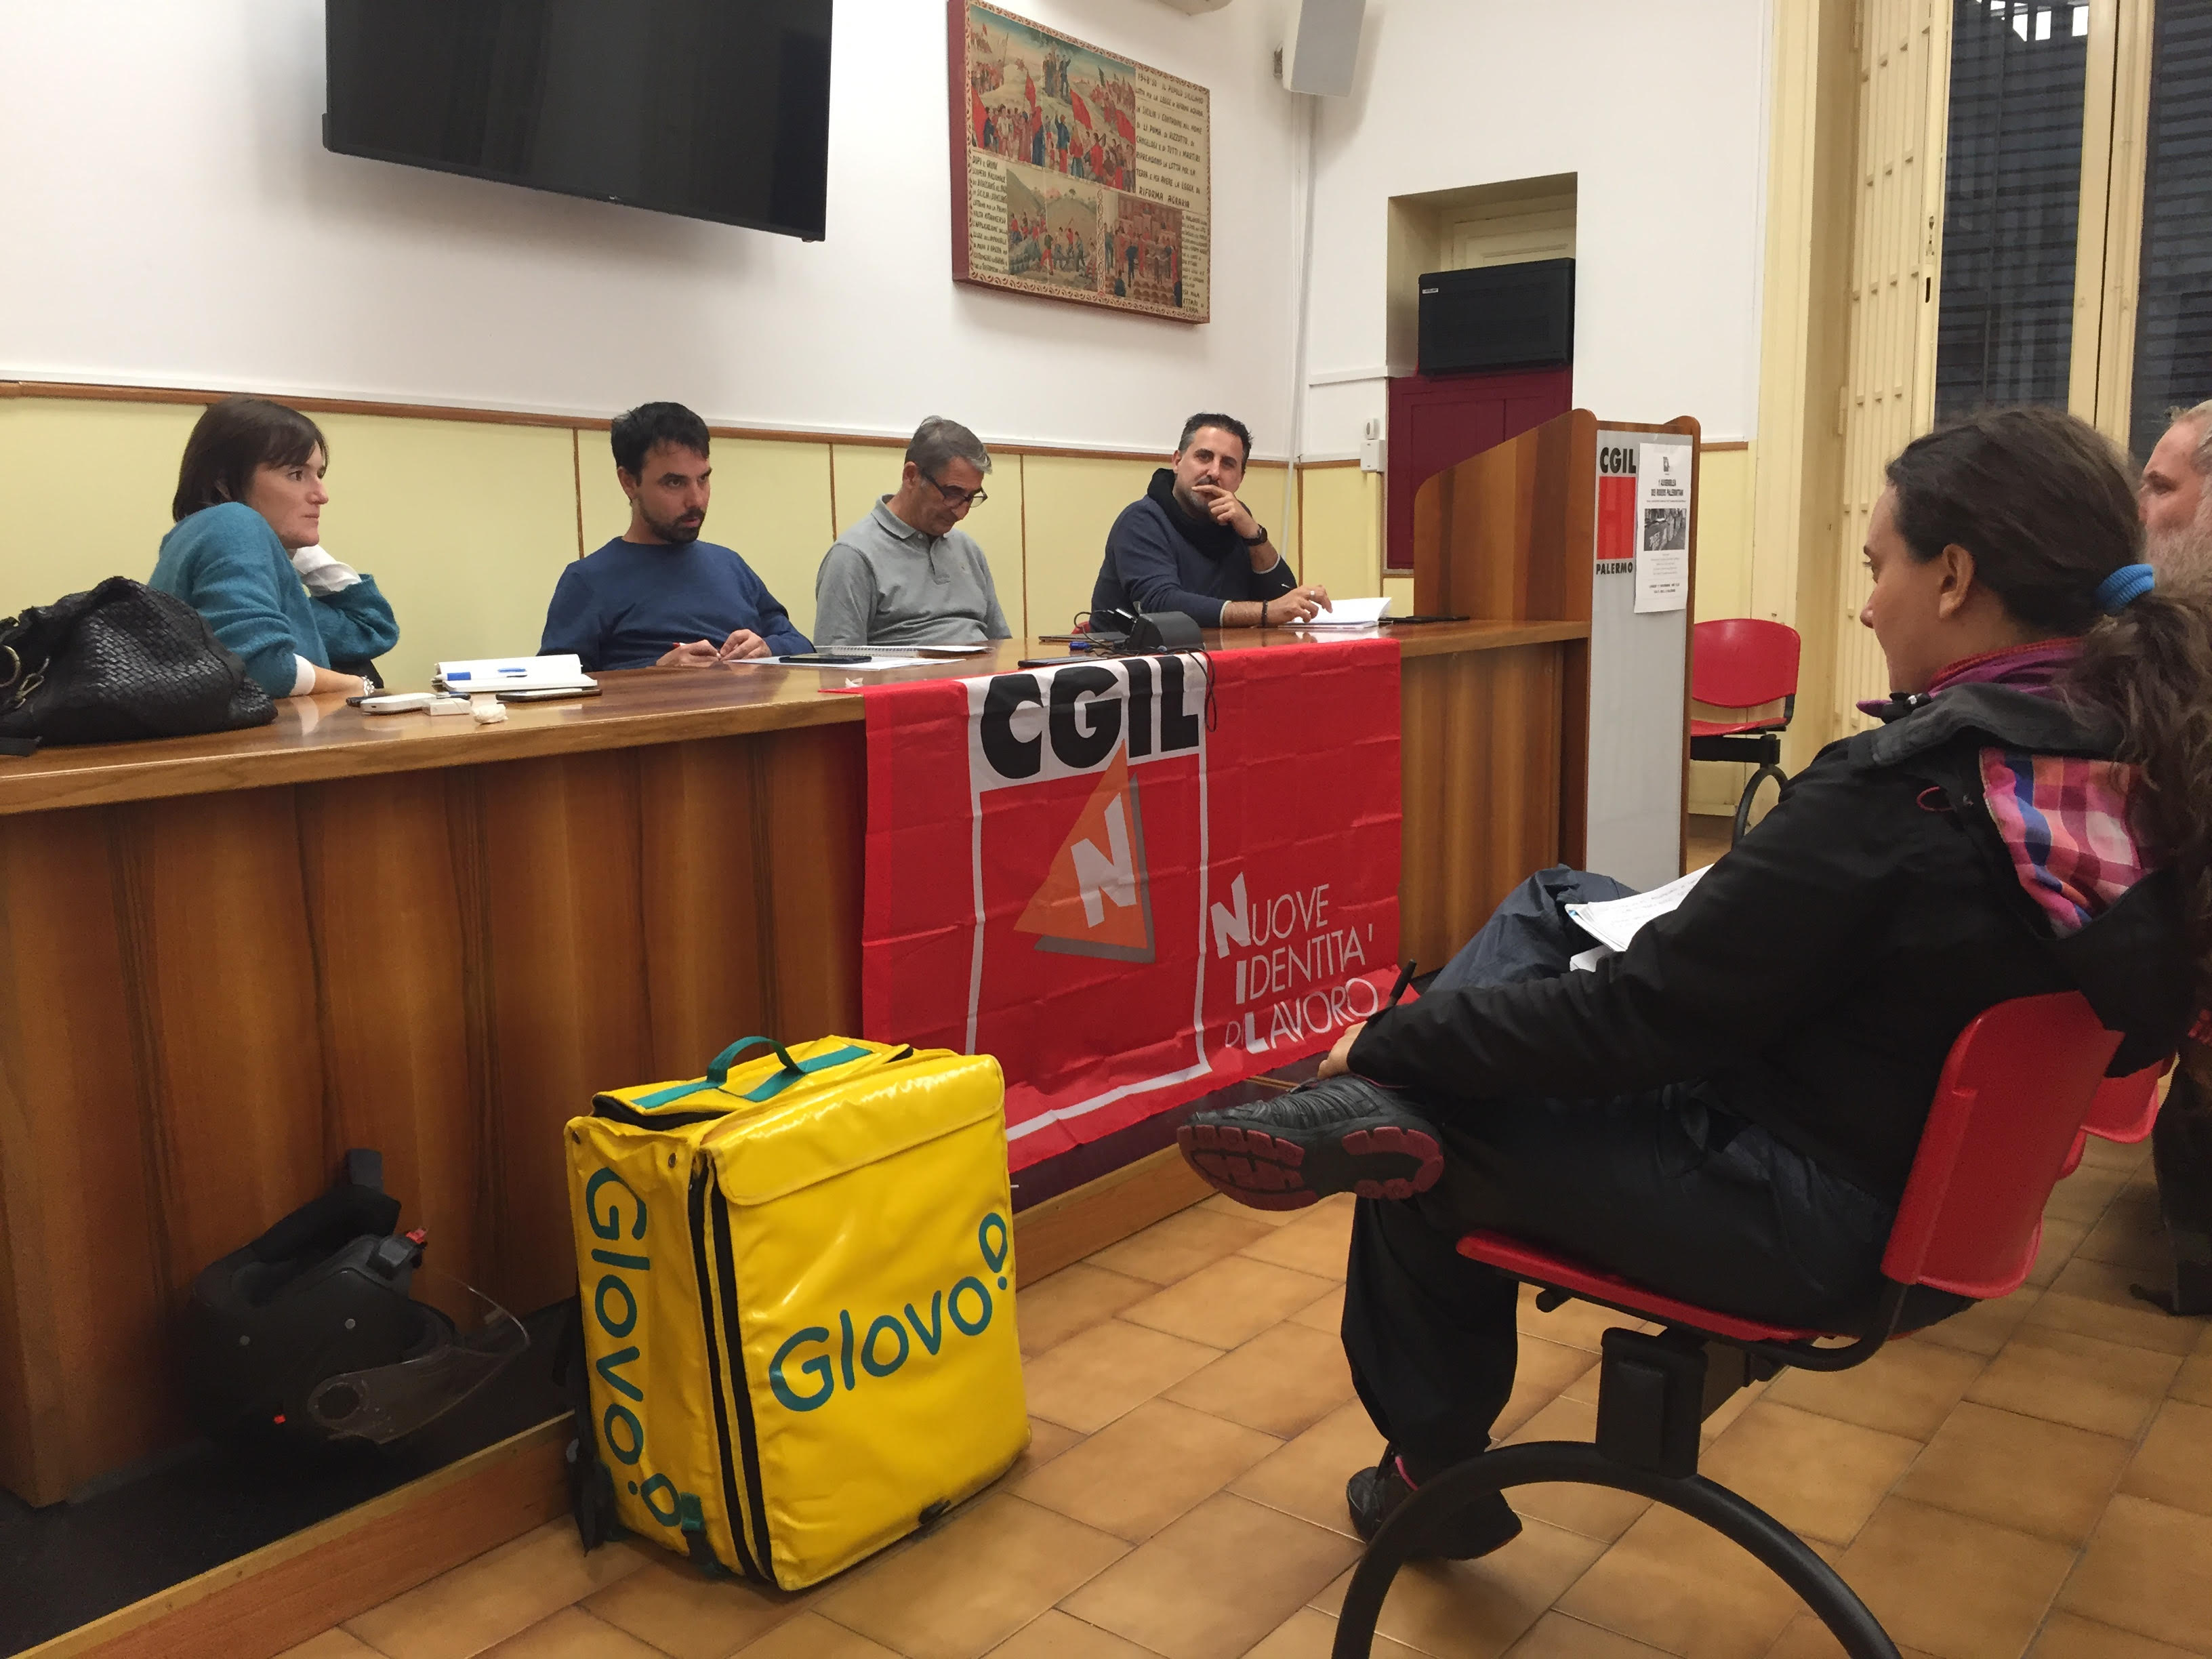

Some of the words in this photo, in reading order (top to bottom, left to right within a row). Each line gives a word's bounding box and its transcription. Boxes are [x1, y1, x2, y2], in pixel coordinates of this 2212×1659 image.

[1139, 186, 1164, 201] RIFORMA
[1599, 447, 1637, 474] CGIL
[1595, 561, 1634, 575] PALERMO
[979, 654, 1200, 779] CGIL
[1070, 792, 1137, 929] N
[1210, 872, 1330, 959] NUOVE
[1235, 923, 1374, 1005] IDENTITA'
[1225, 1019, 1244, 1048] DI
[1244, 977, 1379, 1055] LAVORO
